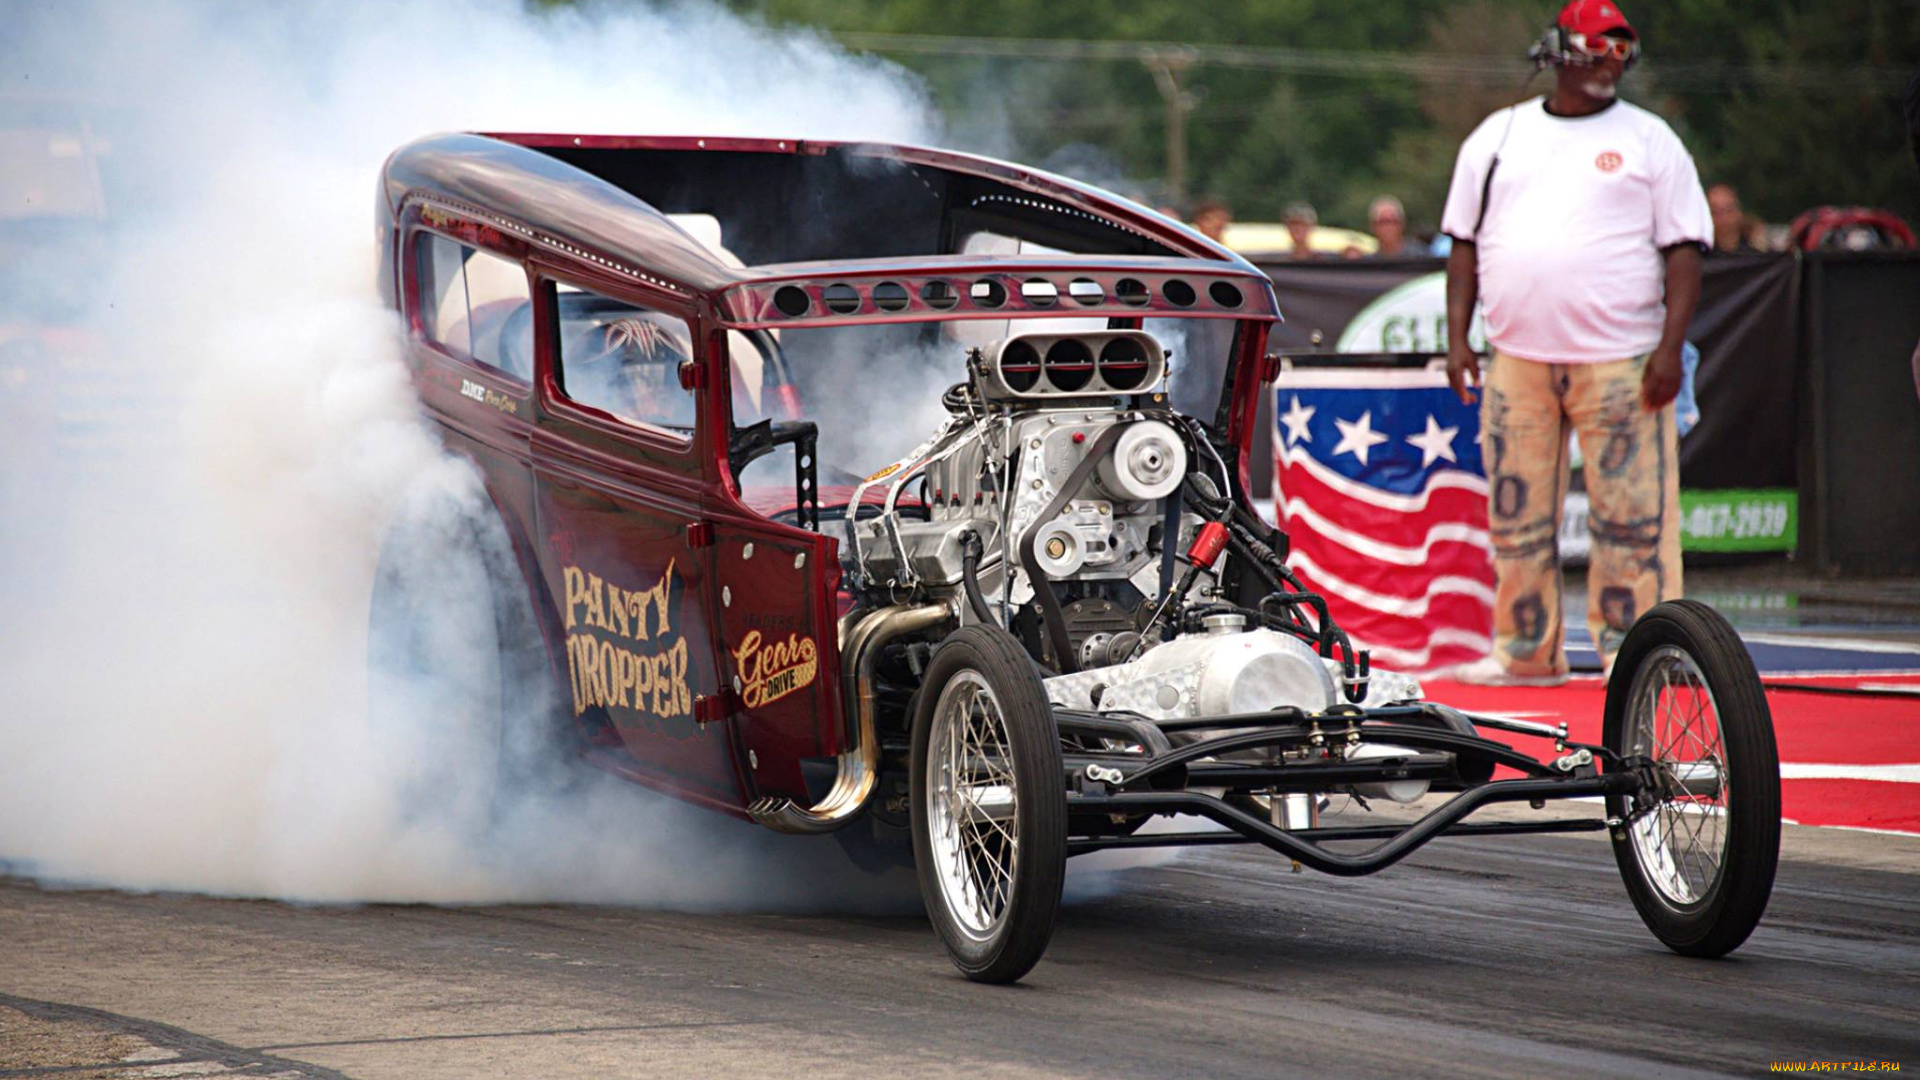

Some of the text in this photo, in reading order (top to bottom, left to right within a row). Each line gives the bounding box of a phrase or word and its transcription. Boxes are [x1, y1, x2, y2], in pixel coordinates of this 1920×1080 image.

[564, 556, 676, 641] PANTY
[566, 633, 691, 719] DROPPER
[767, 669, 796, 698] DRIVE
